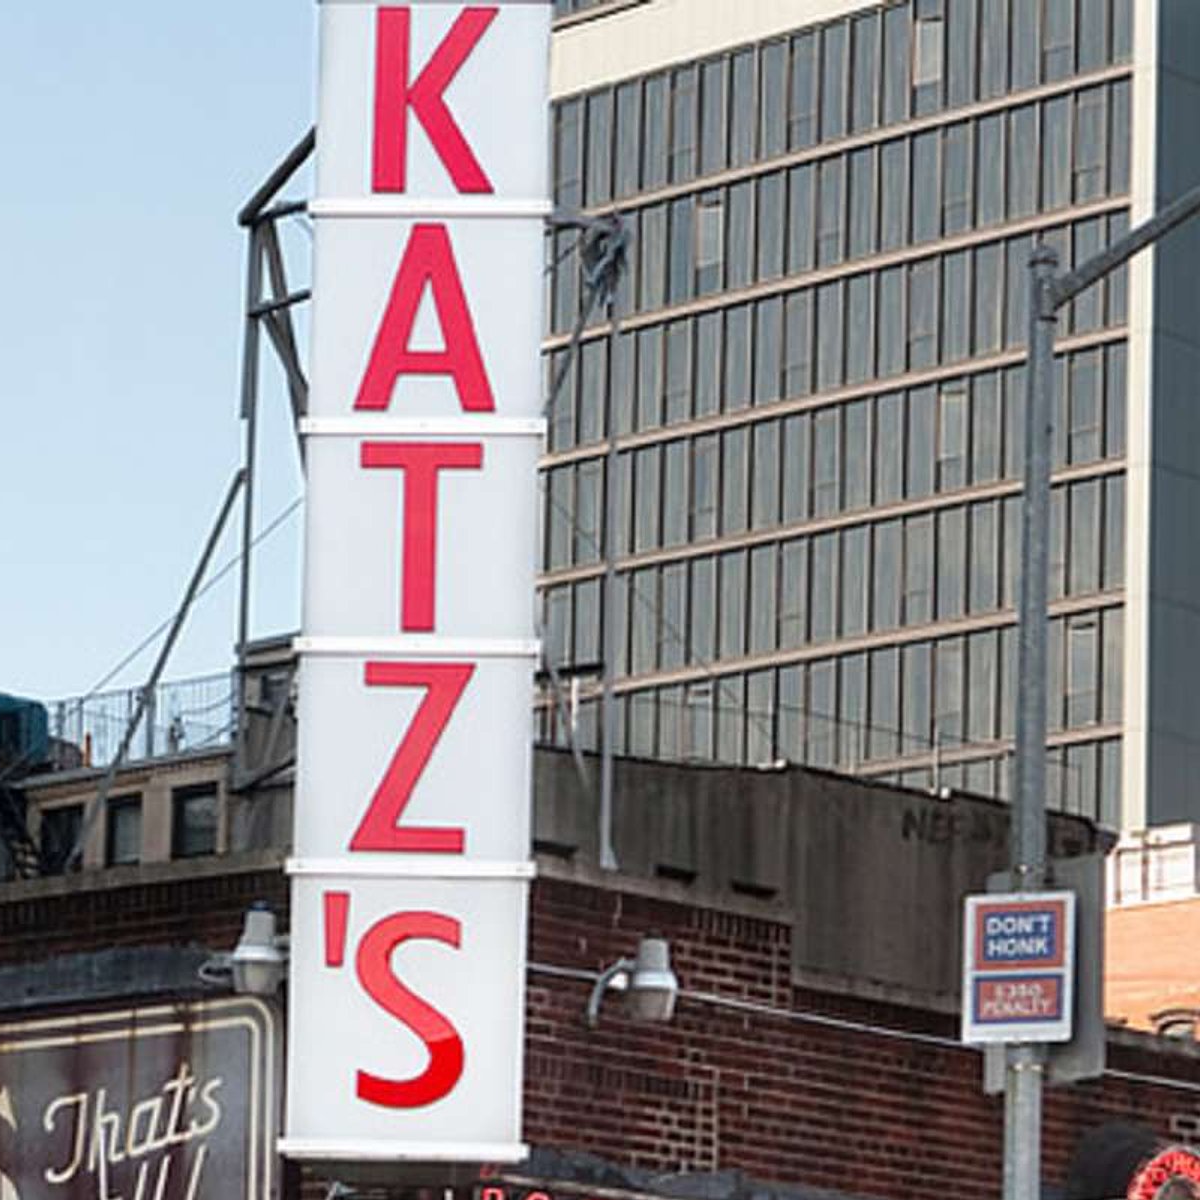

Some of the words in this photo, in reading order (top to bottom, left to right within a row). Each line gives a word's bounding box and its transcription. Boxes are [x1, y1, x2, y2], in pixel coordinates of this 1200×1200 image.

[323, 5, 500, 1110] KATZ'S
[986, 914, 1051, 935] DON'T
[987, 936, 1049, 958] HONK
[44, 1063, 221, 1183] That's
